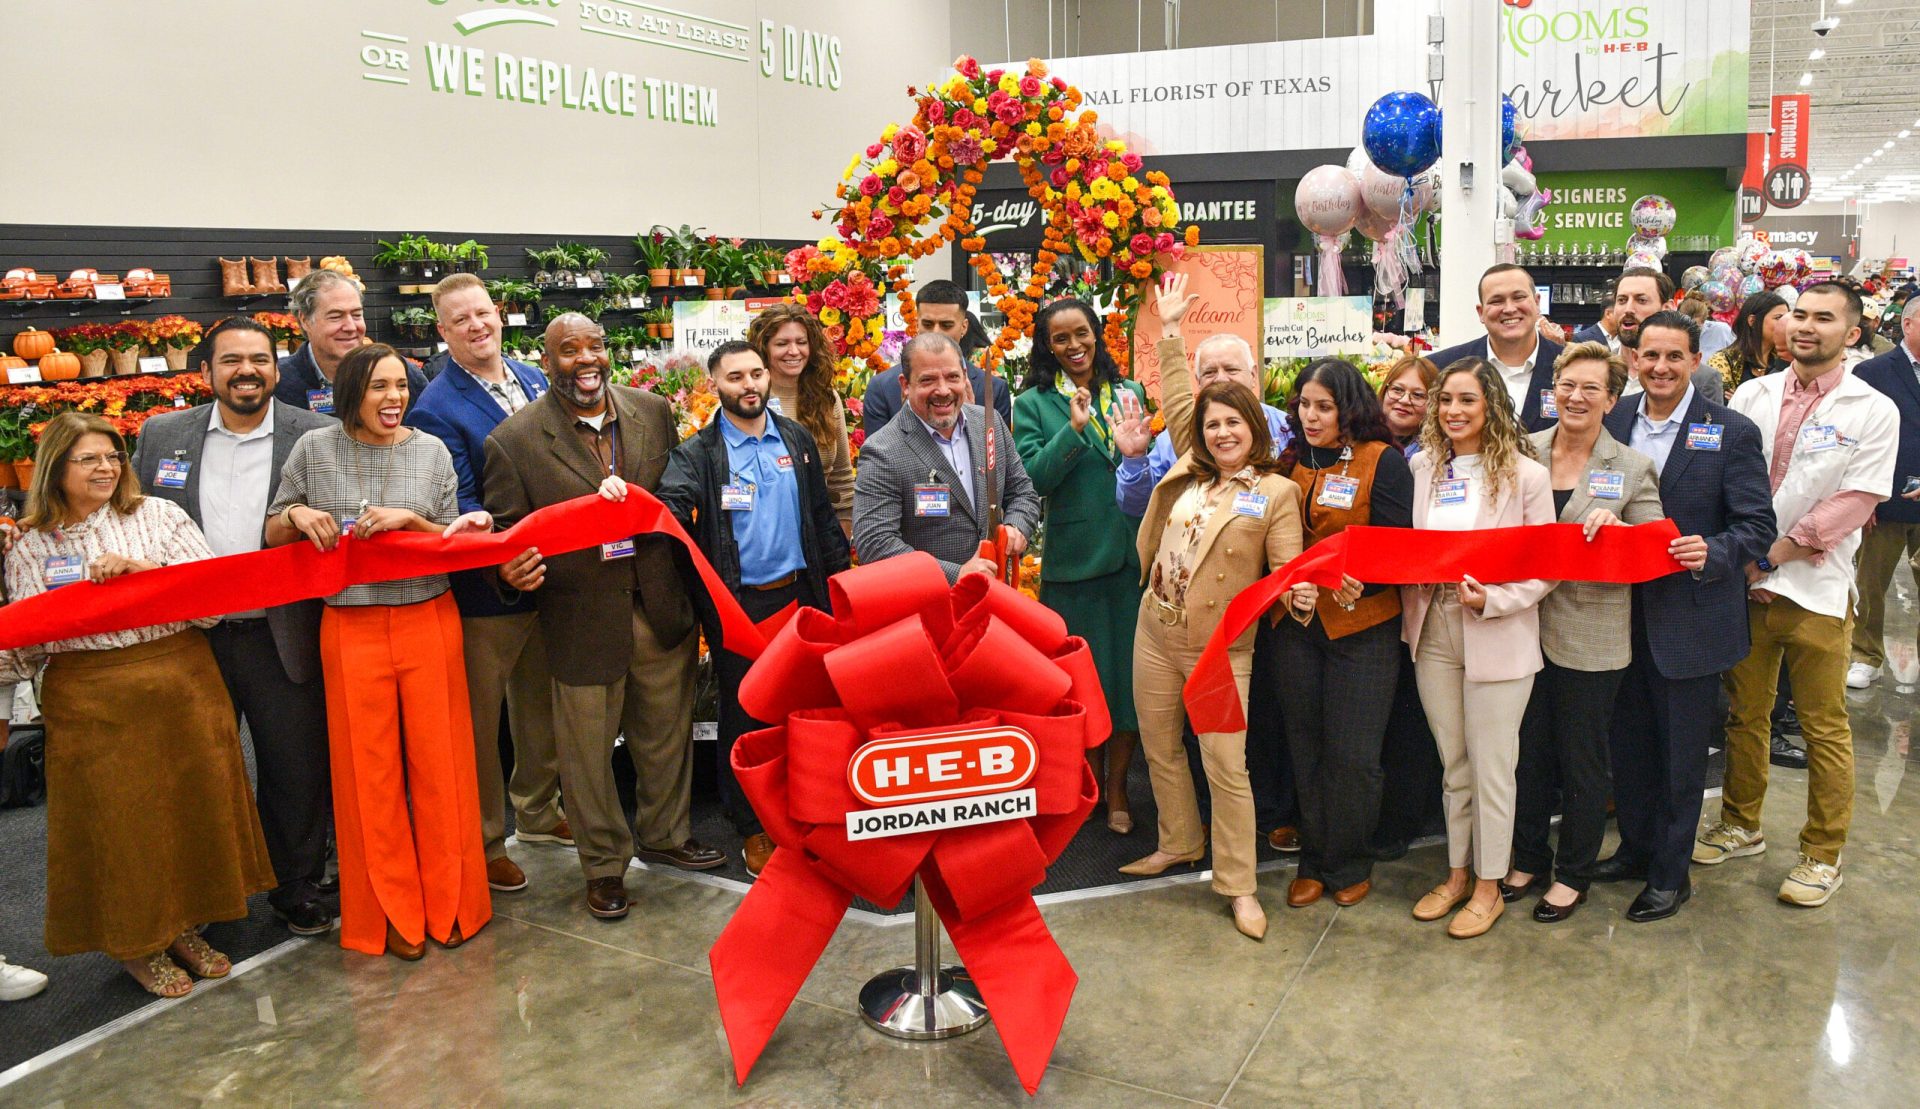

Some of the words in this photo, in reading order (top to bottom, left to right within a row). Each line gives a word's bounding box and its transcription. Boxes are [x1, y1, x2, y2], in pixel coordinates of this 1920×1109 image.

[580, 1, 633, 27] FOR
[639, 14, 672, 35] AT
[676, 22, 750, 51] LEAST
[361, 45, 410, 70] OR
[760, 18, 775, 77] 5
[783, 24, 842, 91] DAYS
[425, 41, 486, 96] WE
[495, 52, 637, 116] REPLACE
[643, 77, 718, 127] THEM
[1084, 90, 1124, 106] NAL
[1130, 83, 1218, 104] FLORIST
[1225, 81, 1253, 97] OF
[1260, 76, 1332, 95] TEXAS
[1509, 42, 1690, 118] arket
[1780, 101, 1798, 159] RESTROOMS
[1551, 188, 1627, 204] SIGNERS
[1743, 196, 1761, 214] TM
[971, 200, 1037, 226] 5-day
[1176, 200, 1256, 221] ARANTEE
[1554, 213, 1624, 228] SERVICE
[1150, 300, 1245, 326] elcome
[702, 328, 729, 336] FRESH
[1306, 326, 1365, 349] Bunches
[853, 808, 946, 834] JORDAN
[953, 796, 1031, 821] RANCH
